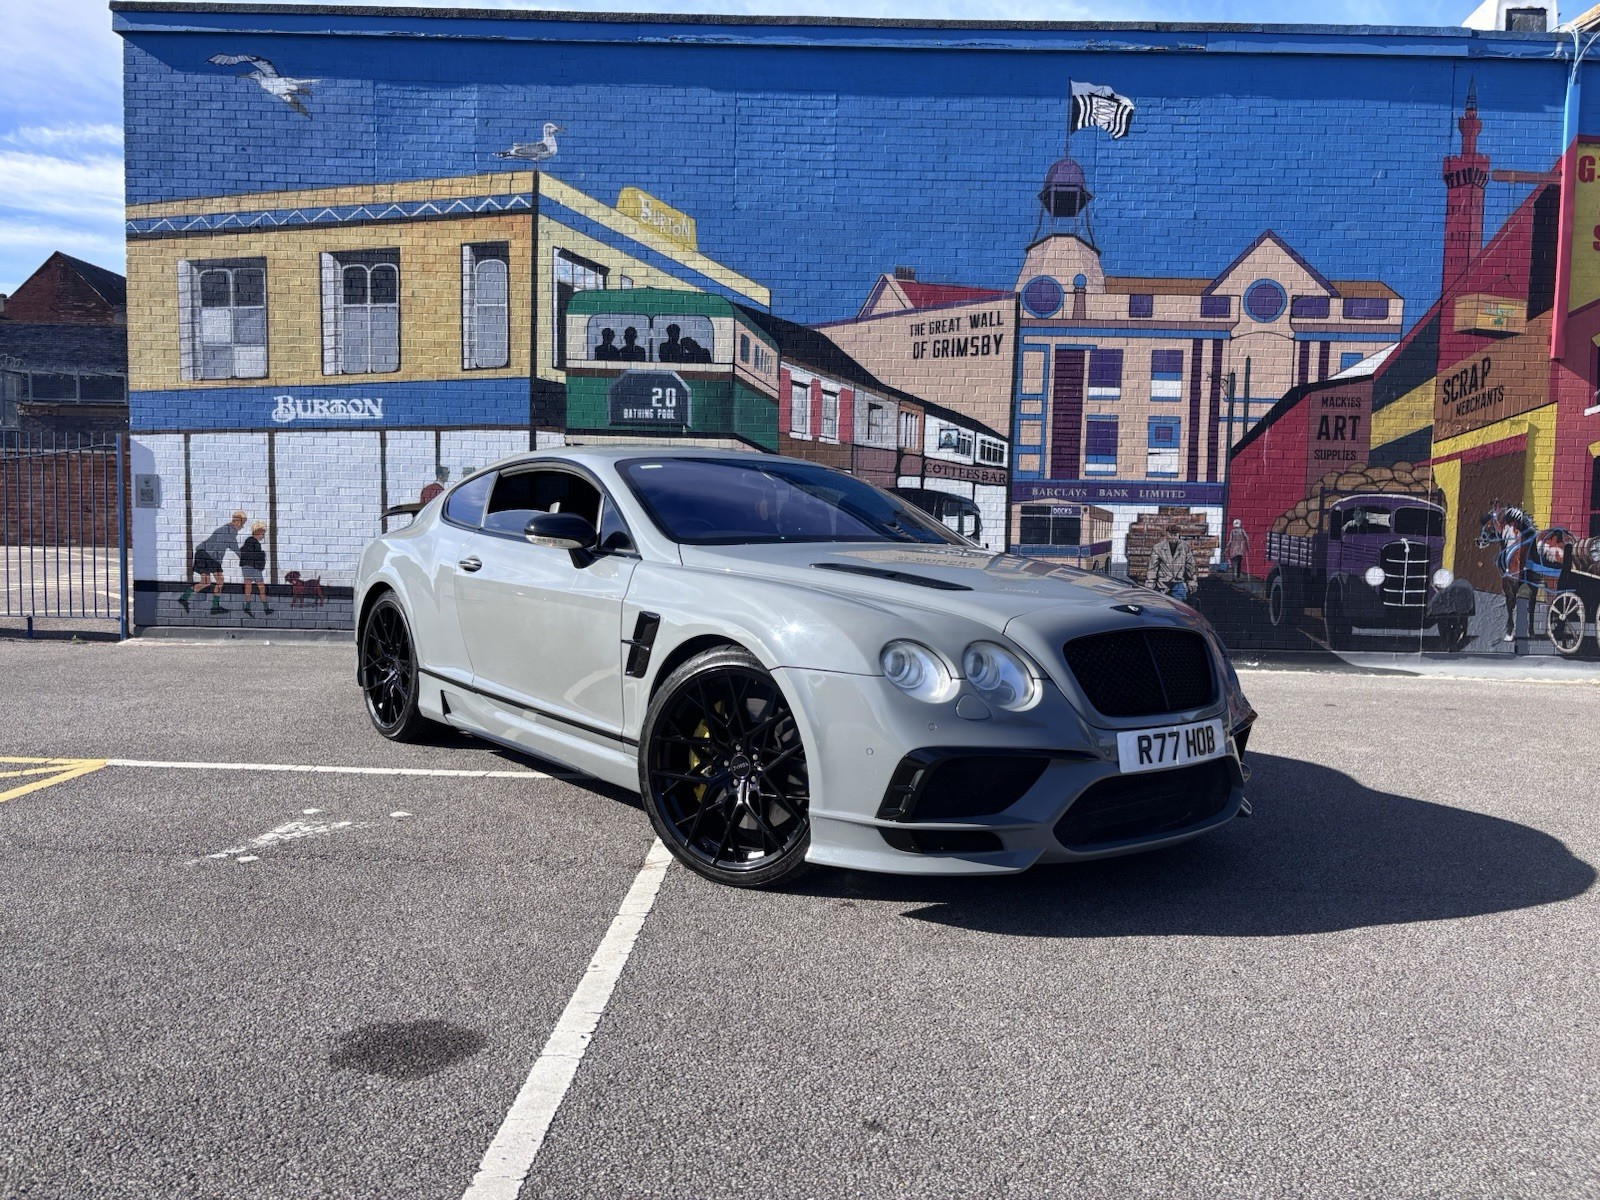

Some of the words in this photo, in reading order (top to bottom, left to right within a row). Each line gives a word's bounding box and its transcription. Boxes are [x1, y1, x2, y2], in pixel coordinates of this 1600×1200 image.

[910, 322, 926, 337] THE
[929, 317, 962, 335] GREAT
[970, 310, 1005, 329] WALL
[913, 340, 928, 360] OF
[932, 333, 1004, 359] GRIMSBY
[1442, 356, 1491, 406] SCRAP
[271, 395, 384, 423] BURTON
[651, 387, 677, 408] 20
[1321, 396, 1362, 408] MACKIES
[1455, 384, 1505, 418] MERCHANTS
[623, 408, 654, 419] BATHING
[657, 408, 676, 420] POOL
[1316, 414, 1361, 441] ART
[1314, 448, 1357, 461] SUPPLIES
[1032, 487, 1087, 497] BARCLAYS
[1099, 488, 1129, 498] BANK
[1139, 489, 1187, 499] LIMITED
[1052, 507, 1073, 515] DOCKS
[1137, 731, 1180, 765] R77
[1185, 725, 1216, 758] HOB
